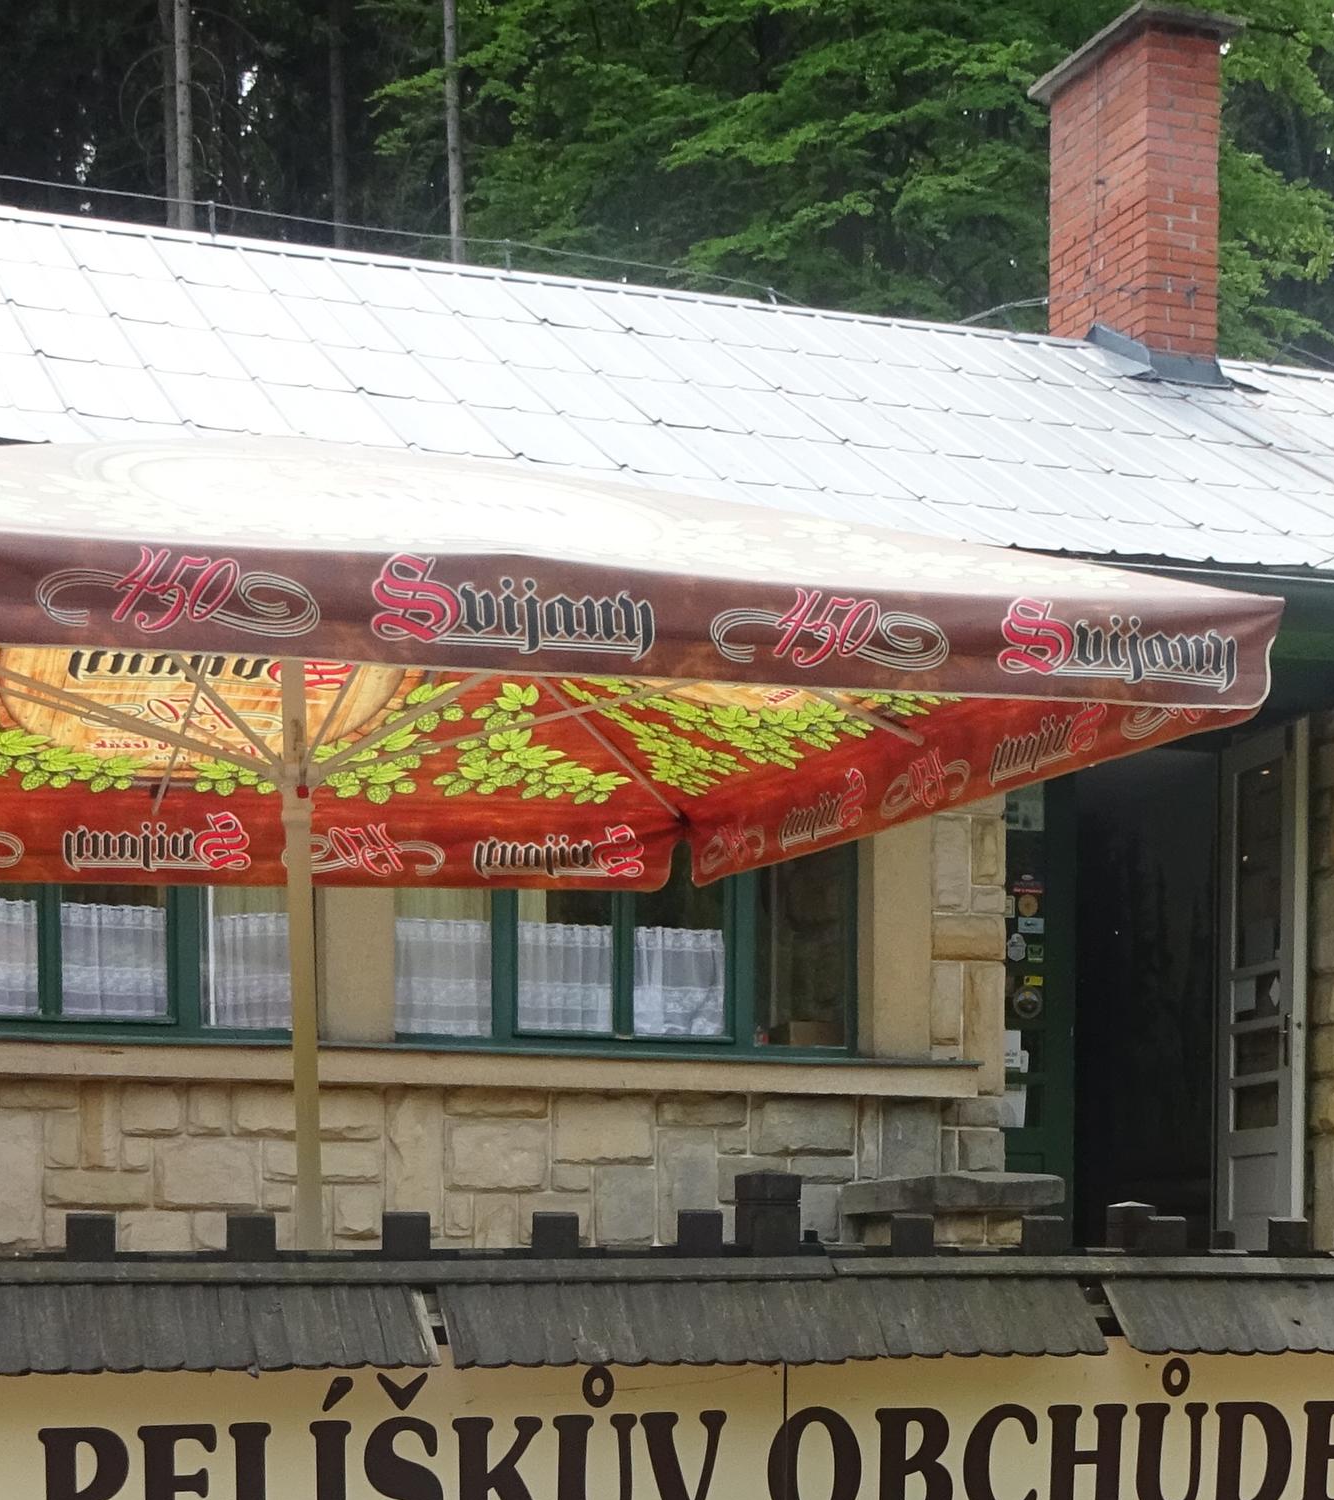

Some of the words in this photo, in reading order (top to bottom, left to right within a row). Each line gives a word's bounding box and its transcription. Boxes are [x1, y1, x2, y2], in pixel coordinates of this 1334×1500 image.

[111, 545, 239, 633] 450
[369, 552, 655, 662] Svijany
[773, 587, 881, 668] 450
[997, 596, 1237, 694] Svijany
